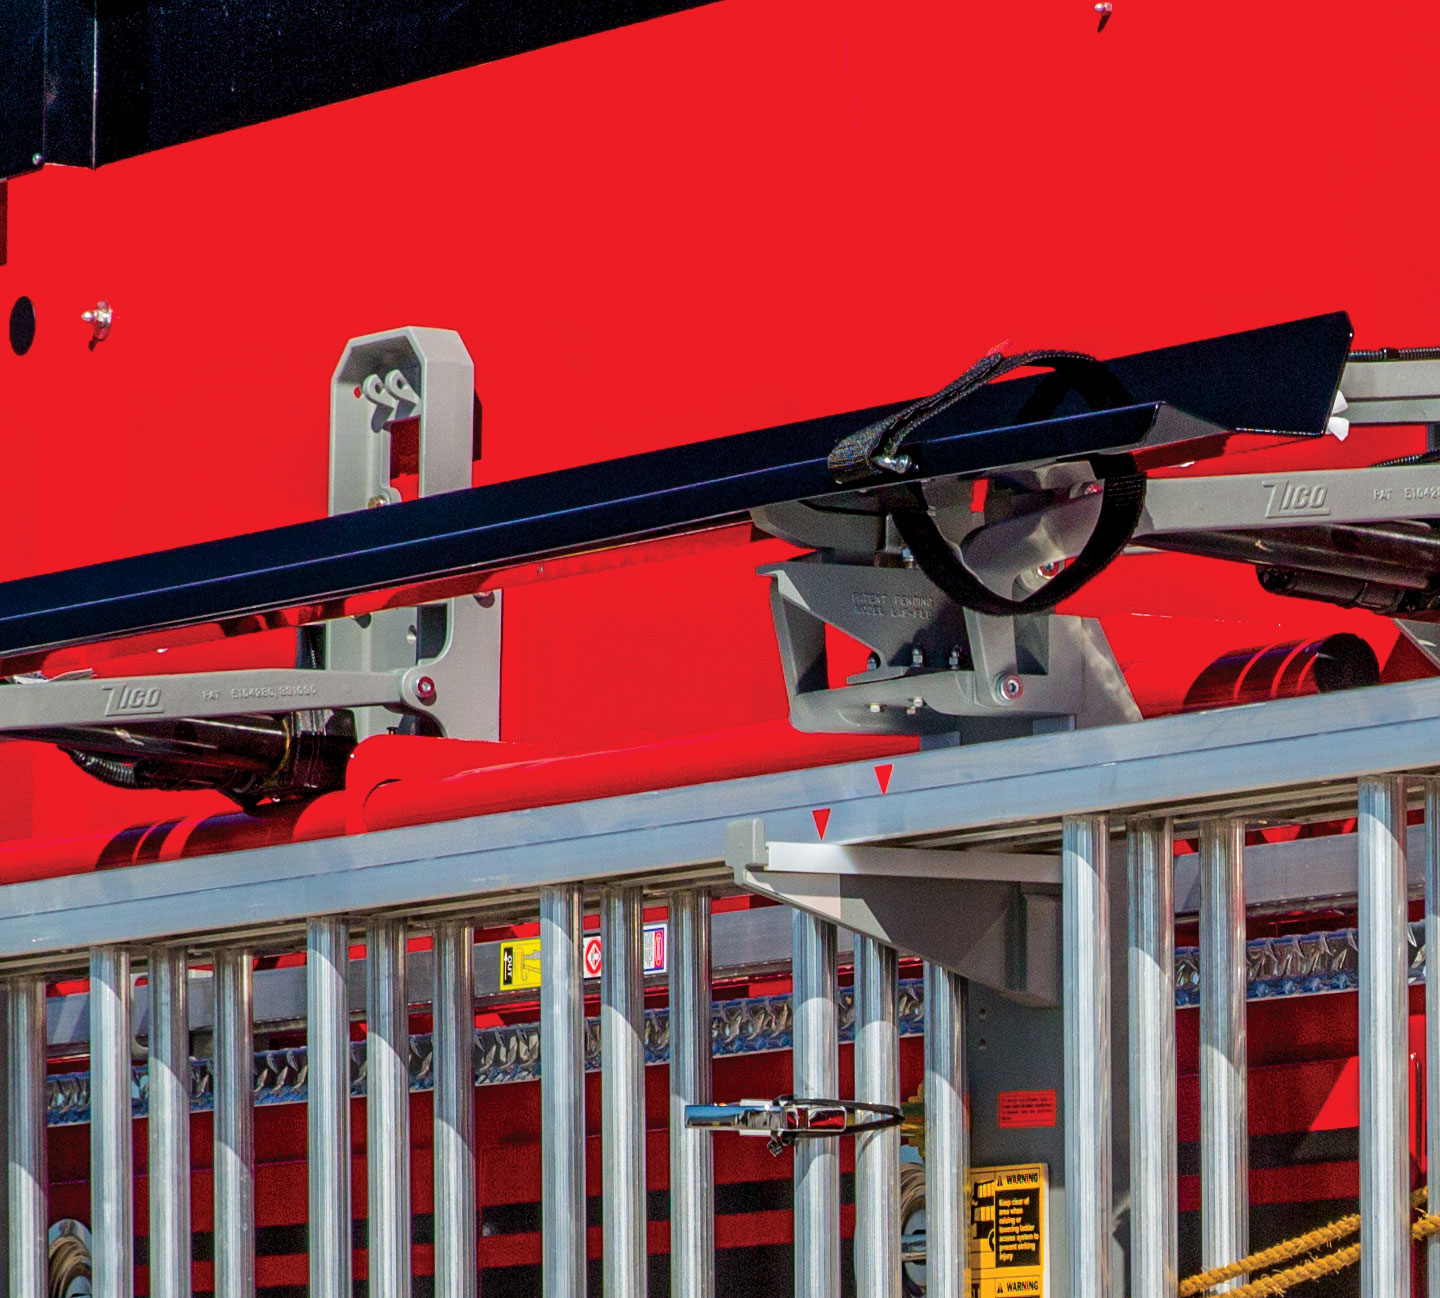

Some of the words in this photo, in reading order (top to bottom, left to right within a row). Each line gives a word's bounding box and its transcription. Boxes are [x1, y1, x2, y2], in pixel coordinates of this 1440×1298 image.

[1262, 478, 1331, 519] ZICO
[101, 681, 166, 717] ZICO
[1007, 1173, 1038, 1184] WARNING
[1007, 1281, 1038, 1293] WARNING
